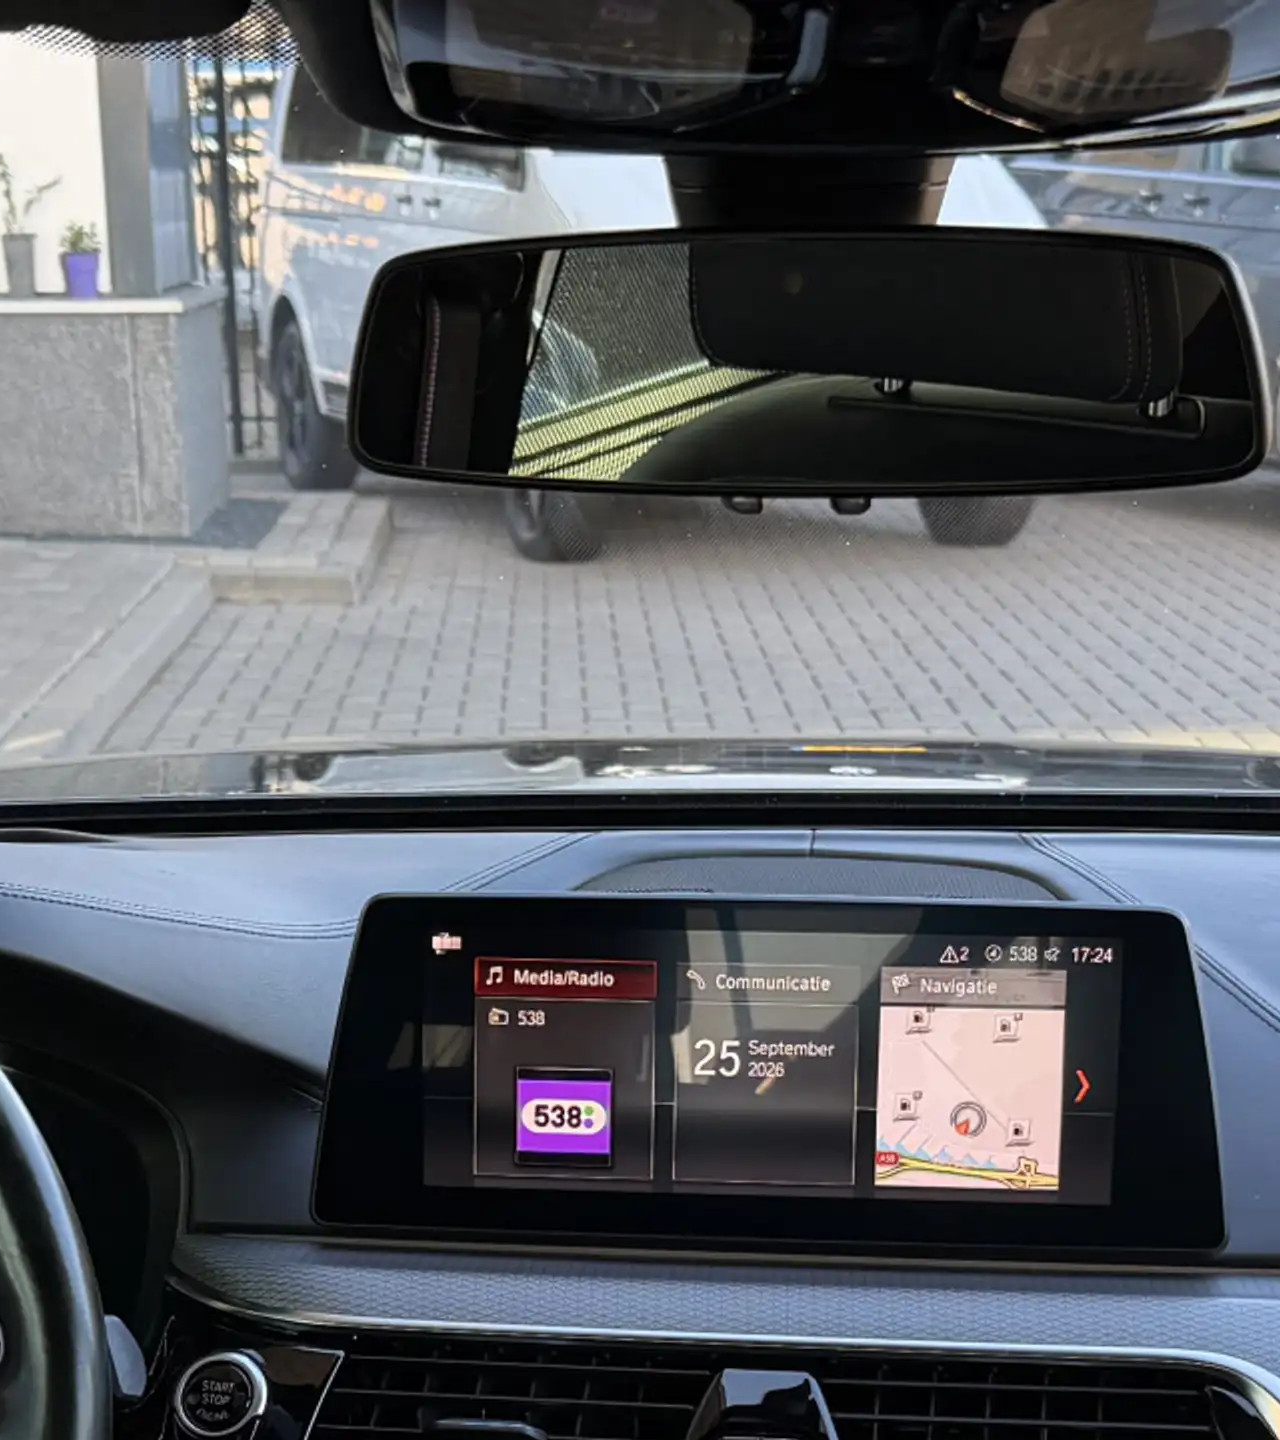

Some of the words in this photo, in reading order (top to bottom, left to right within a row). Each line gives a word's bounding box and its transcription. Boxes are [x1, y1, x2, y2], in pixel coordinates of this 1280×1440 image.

[960, 947, 969, 962] 2
[1008, 946, 1038, 962] 538
[1072, 947, 1114, 964] 17:24
[513, 969, 616, 988] Media/Radio
[715, 974, 831, 993] Communicatie
[919, 978, 998, 997] Navigatie
[516, 1009, 546, 1026] 538
[692, 1039, 741, 1078] 25
[748, 1040, 835, 1059] September
[748, 1061, 785, 1079] 2026
[533, 1104, 583, 1128] 538
[200, 1380, 237, 1393] START
[200, 1392, 233, 1406] STOP
